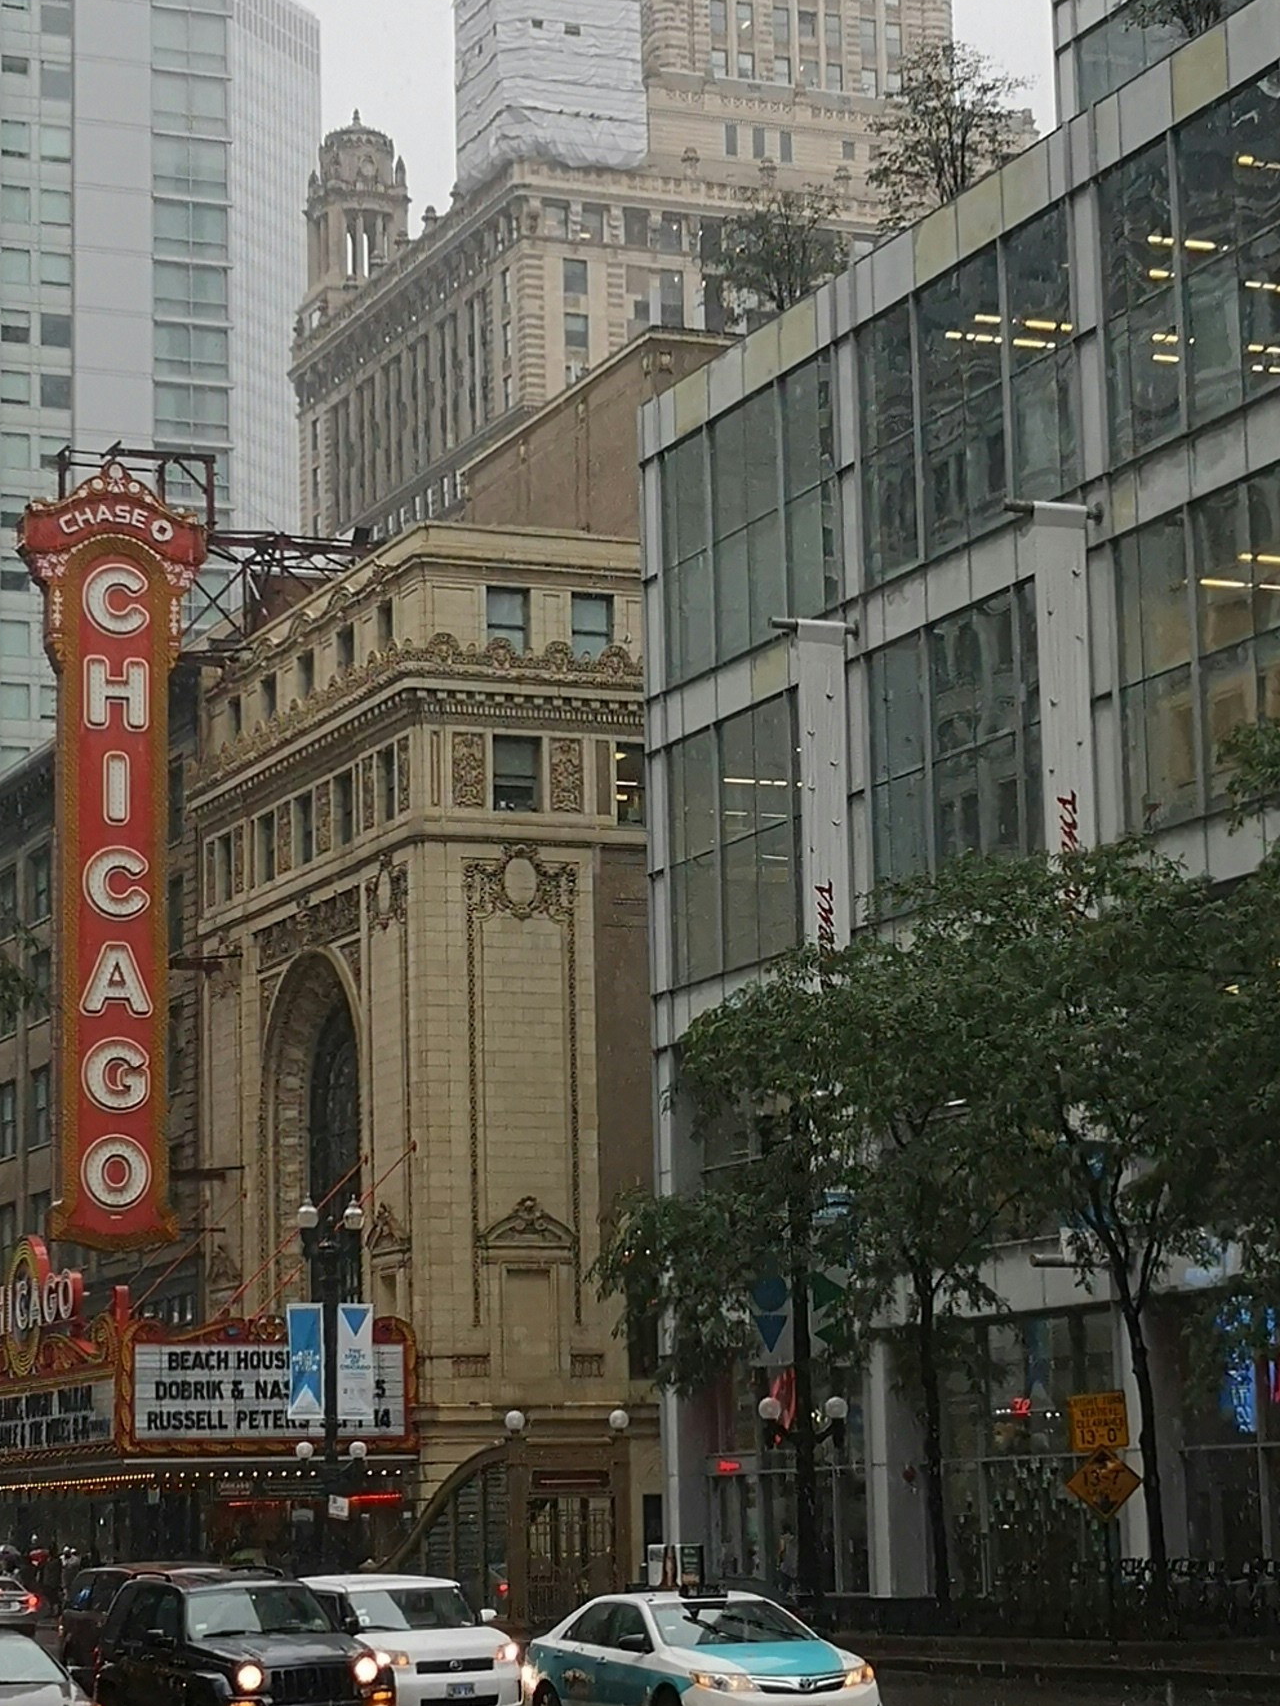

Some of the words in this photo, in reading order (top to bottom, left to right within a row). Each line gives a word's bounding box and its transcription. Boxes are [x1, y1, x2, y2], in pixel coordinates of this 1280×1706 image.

[59, 504, 149, 534] CHASE
[80, 563, 152, 1212] CHICAGO
[168, 1351, 229, 1371] BEACH
[236, 1350, 290, 1371] HOUS
[155, 1380, 224, 1401] DOBRIK
[231, 1380, 244, 1400] &
[255, 1380, 290, 1401] NAS
[147, 1410, 228, 1431] RUSSELL
